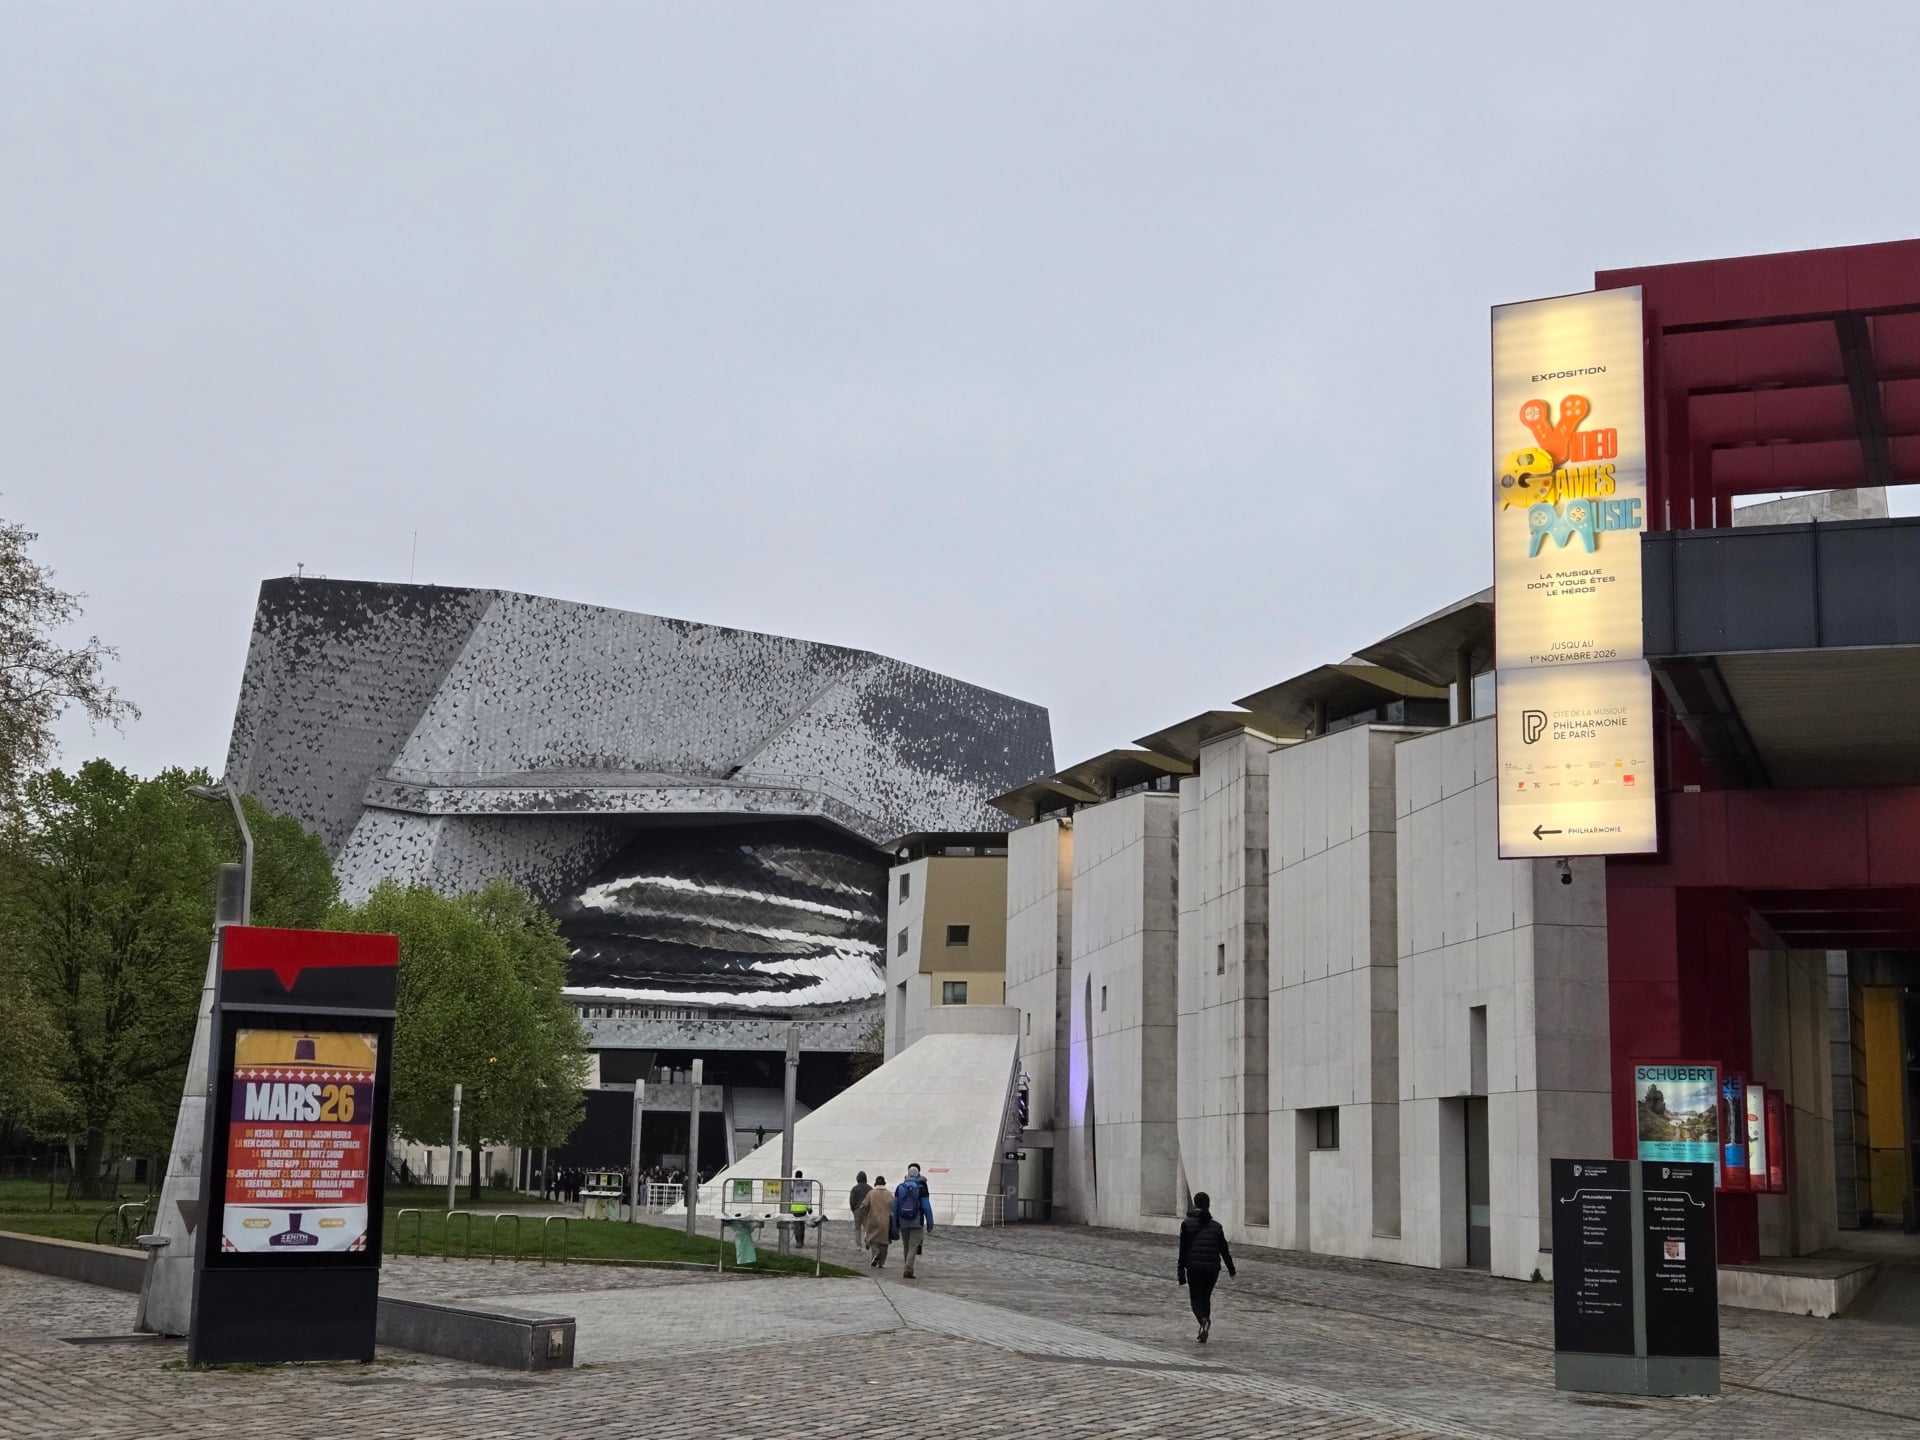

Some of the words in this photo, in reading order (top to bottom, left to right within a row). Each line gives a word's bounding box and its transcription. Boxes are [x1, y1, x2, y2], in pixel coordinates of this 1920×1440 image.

[1531, 366, 1607, 382] EXPOSITION
[1500, 447, 1617, 509] GAMES
[1528, 497, 1642, 559] MUSIC
[1539, 572, 1552, 580] LA
[1556, 568, 1603, 578] MUSIQUE
[1527, 581, 1554, 590] DONT
[1558, 579, 1587, 587] VOUS
[1550, 639, 1594, 651] JUSQU'AU
[1541, 651, 1591, 662] NOVEMBRE
[1593, 650, 1617, 659] 2026
[1593, 707, 1628, 716] MUSIQUE
[1553, 717, 1628, 730] PHILHARMONIE
[1553, 731, 1567, 740] DE
[1569, 729, 1596, 739] PARIS
[1567, 826, 1622, 834] PHILHARMONIE
[1637, 1067, 1716, 1081] SCHUBERT
[254, 1129, 274, 1138] KESHA
[255, 1139, 280, 1148] CARSON
[260, 1149, 272, 1158] THE
